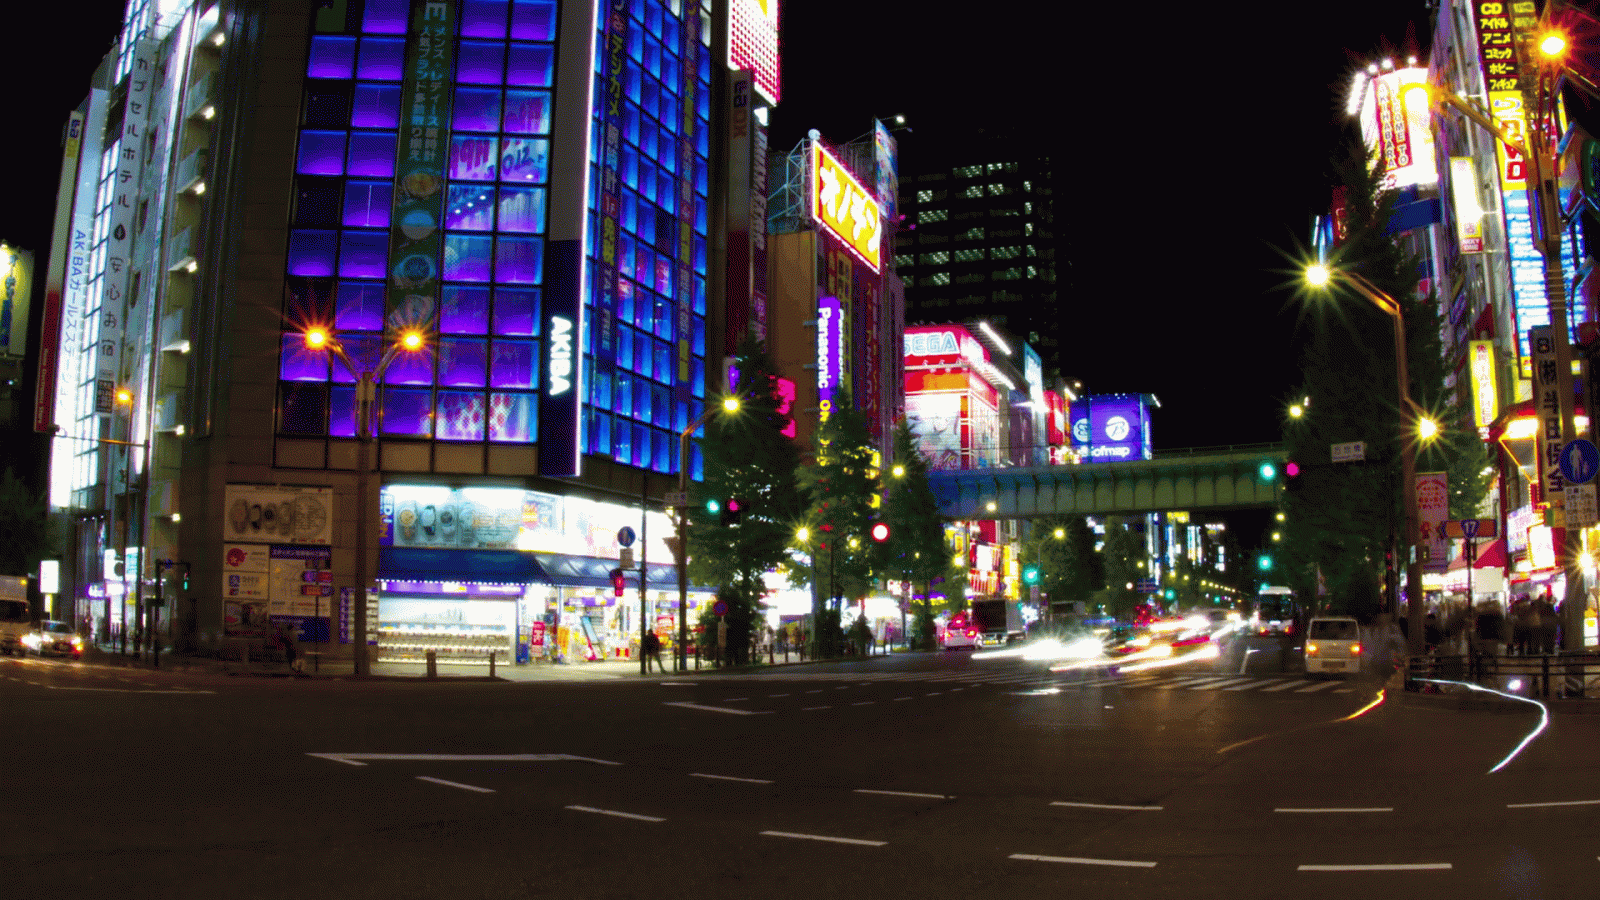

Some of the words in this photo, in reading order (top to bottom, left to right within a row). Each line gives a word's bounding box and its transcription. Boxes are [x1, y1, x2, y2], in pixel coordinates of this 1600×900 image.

[1480, 2, 1503, 15] CD
[1480, 17, 1509, 30] アイドル
[1482, 32, 1512, 45] アニメ
[1485, 47, 1513, 60] コミック
[1489, 62, 1515, 76] ホビー
[1489, 77, 1518, 91] フィギュア
[1390, 80, 1405, 142] LCOME
[118, 57, 148, 208] カプセルホテル
[1397, 145, 1409, 166] TO
[818, 306, 832, 389] Panasonic
[549, 315, 573, 396] AKIBA
[1464, 522, 1477, 534] 17
